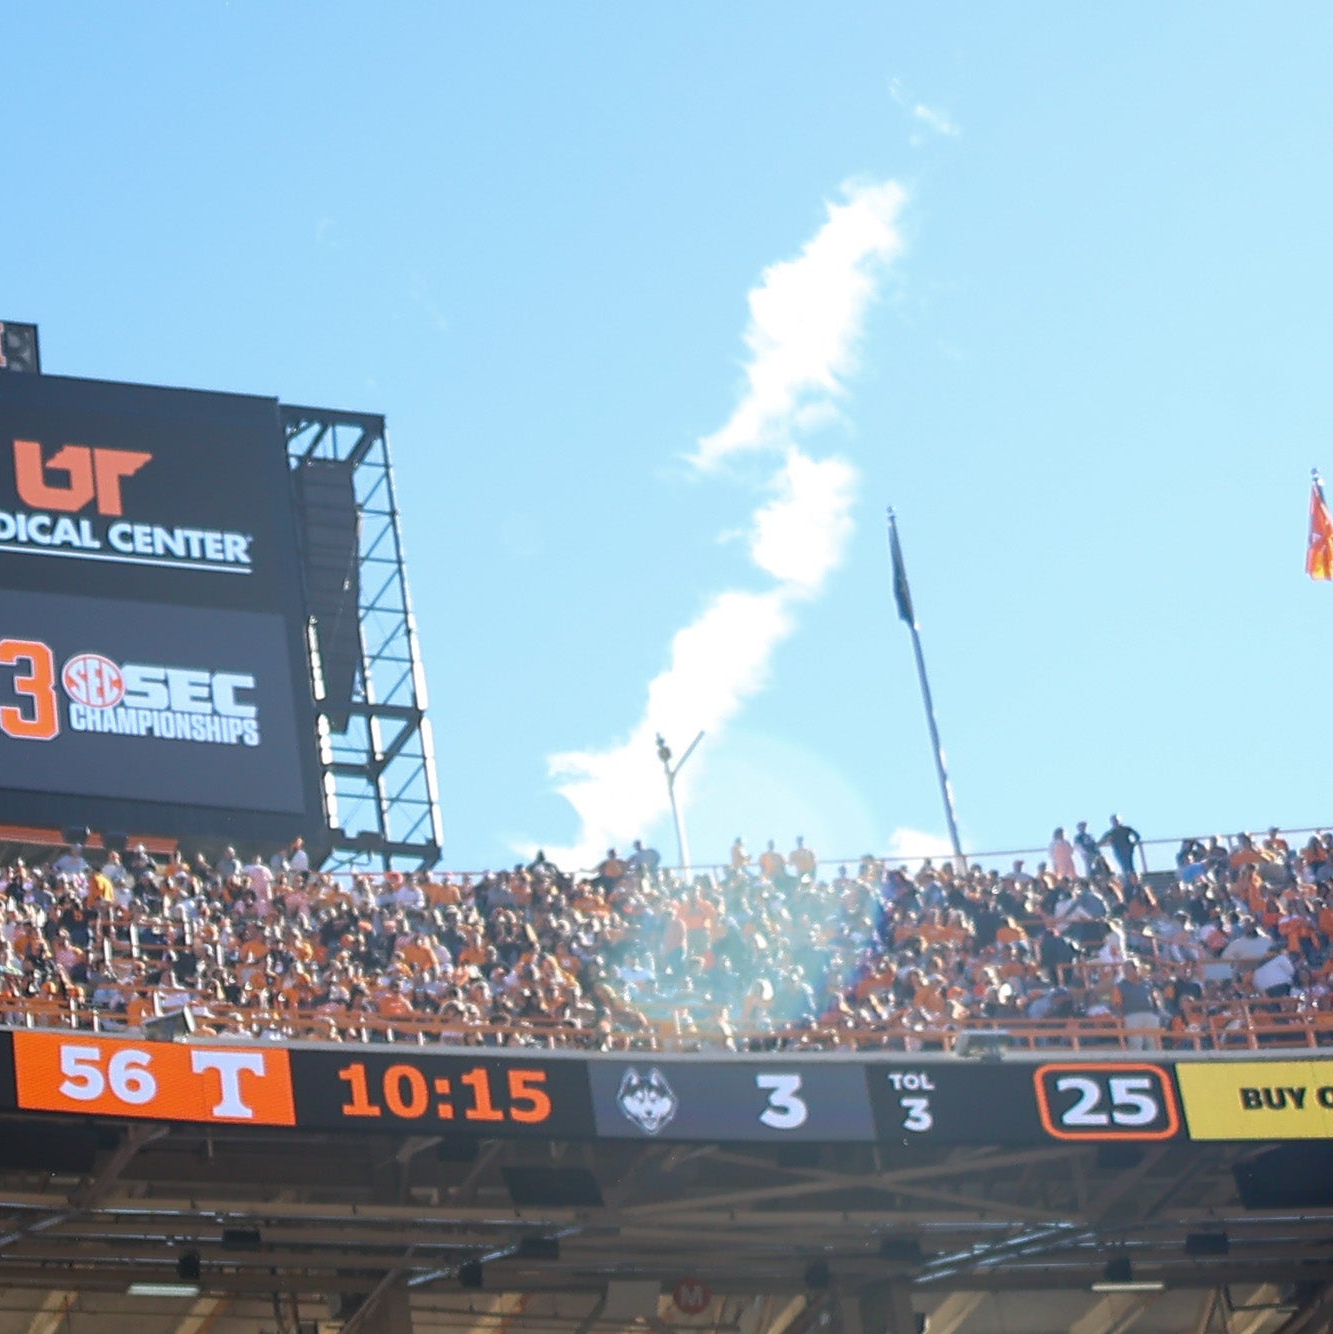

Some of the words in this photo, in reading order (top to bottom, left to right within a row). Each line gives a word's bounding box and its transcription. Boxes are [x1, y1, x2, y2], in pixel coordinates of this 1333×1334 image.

[13, 440, 153, 516] UT
[108, 522, 252, 564] CENTER
[64, 657, 124, 706] SEC
[121, 661, 257, 719] SEC
[69, 704, 261, 747] CHAMPIONSHIPS
[58, 1045, 158, 1105] 56
[191, 1049, 266, 1118] T
[337, 1063, 553, 1123] 10:15
[756, 1074, 808, 1130] 3
[889, 1072, 935, 1092] TOL
[1056, 1077, 1160, 1127] 25
[1240, 1087, 1306, 1110] BUY
[900, 1097, 933, 1133] 3
[680, 1287, 704, 1307] M
